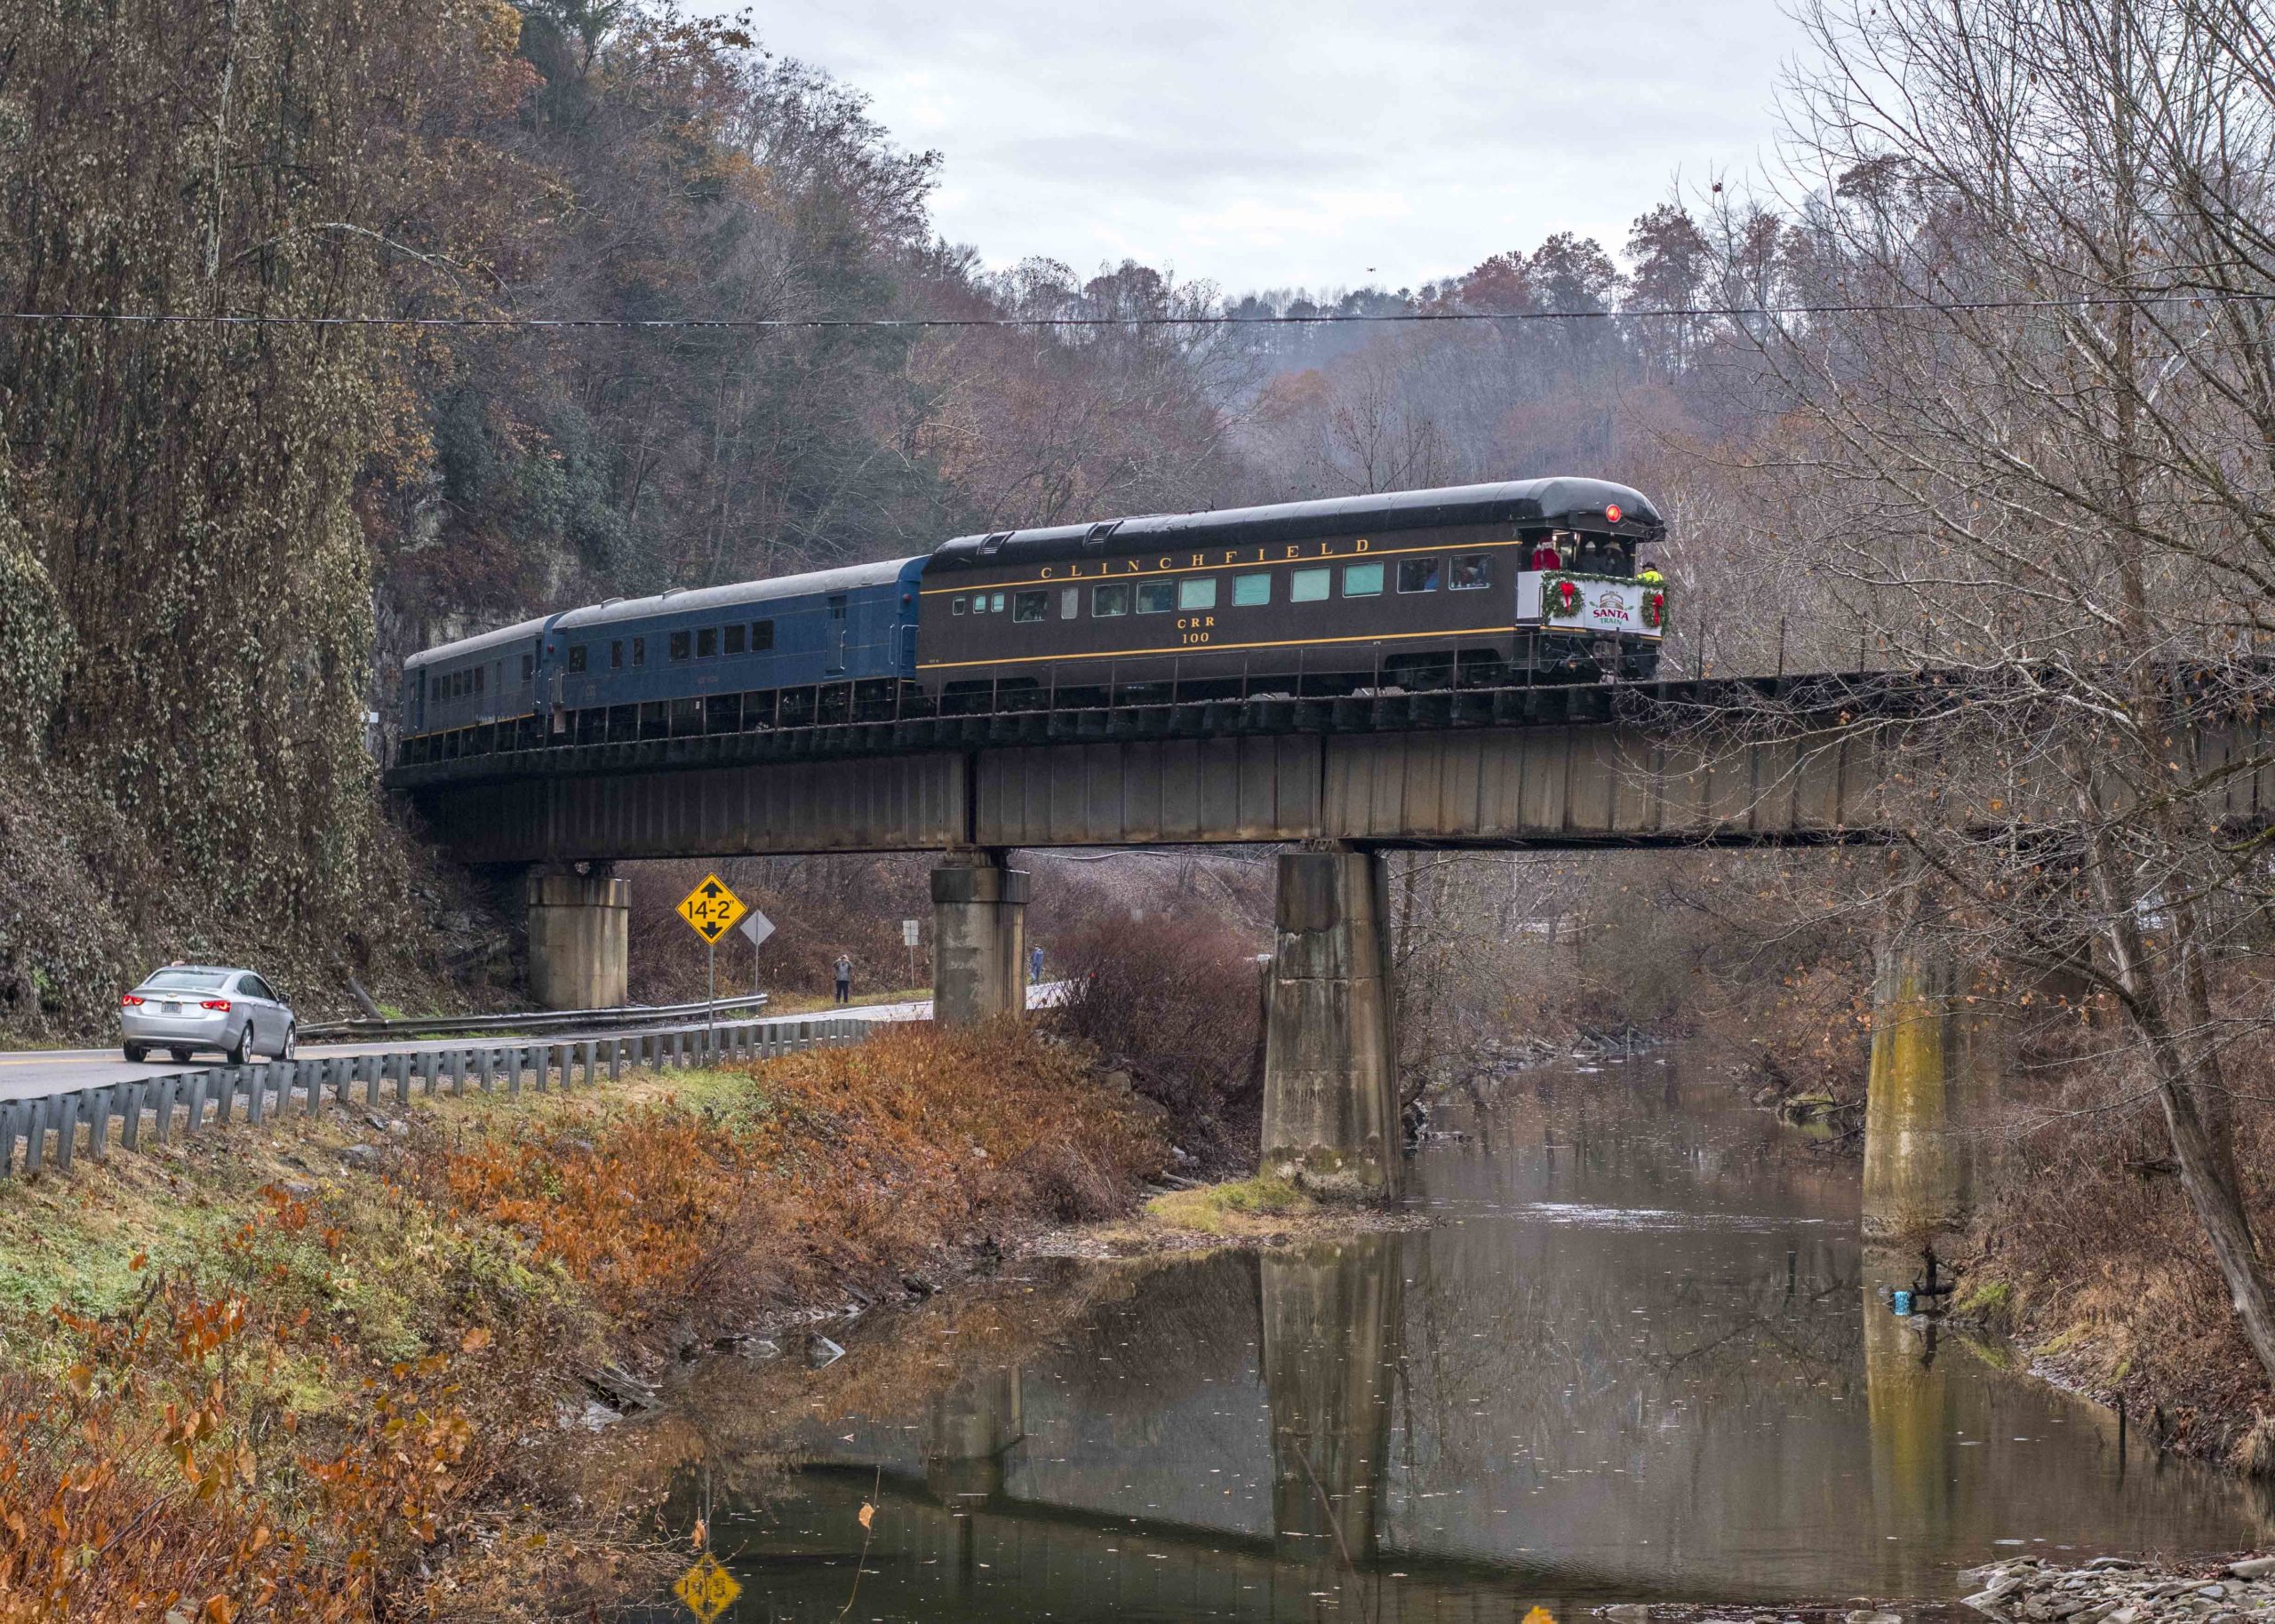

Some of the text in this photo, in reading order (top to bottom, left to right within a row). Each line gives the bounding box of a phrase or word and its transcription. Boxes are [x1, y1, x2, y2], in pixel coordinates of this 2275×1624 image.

[1041, 539, 1369, 578] CLINCHFIELD
[1592, 609, 1629, 621] SANTA
[1177, 617, 1215, 629] CRR
[1183, 633, 1209, 644] 100
